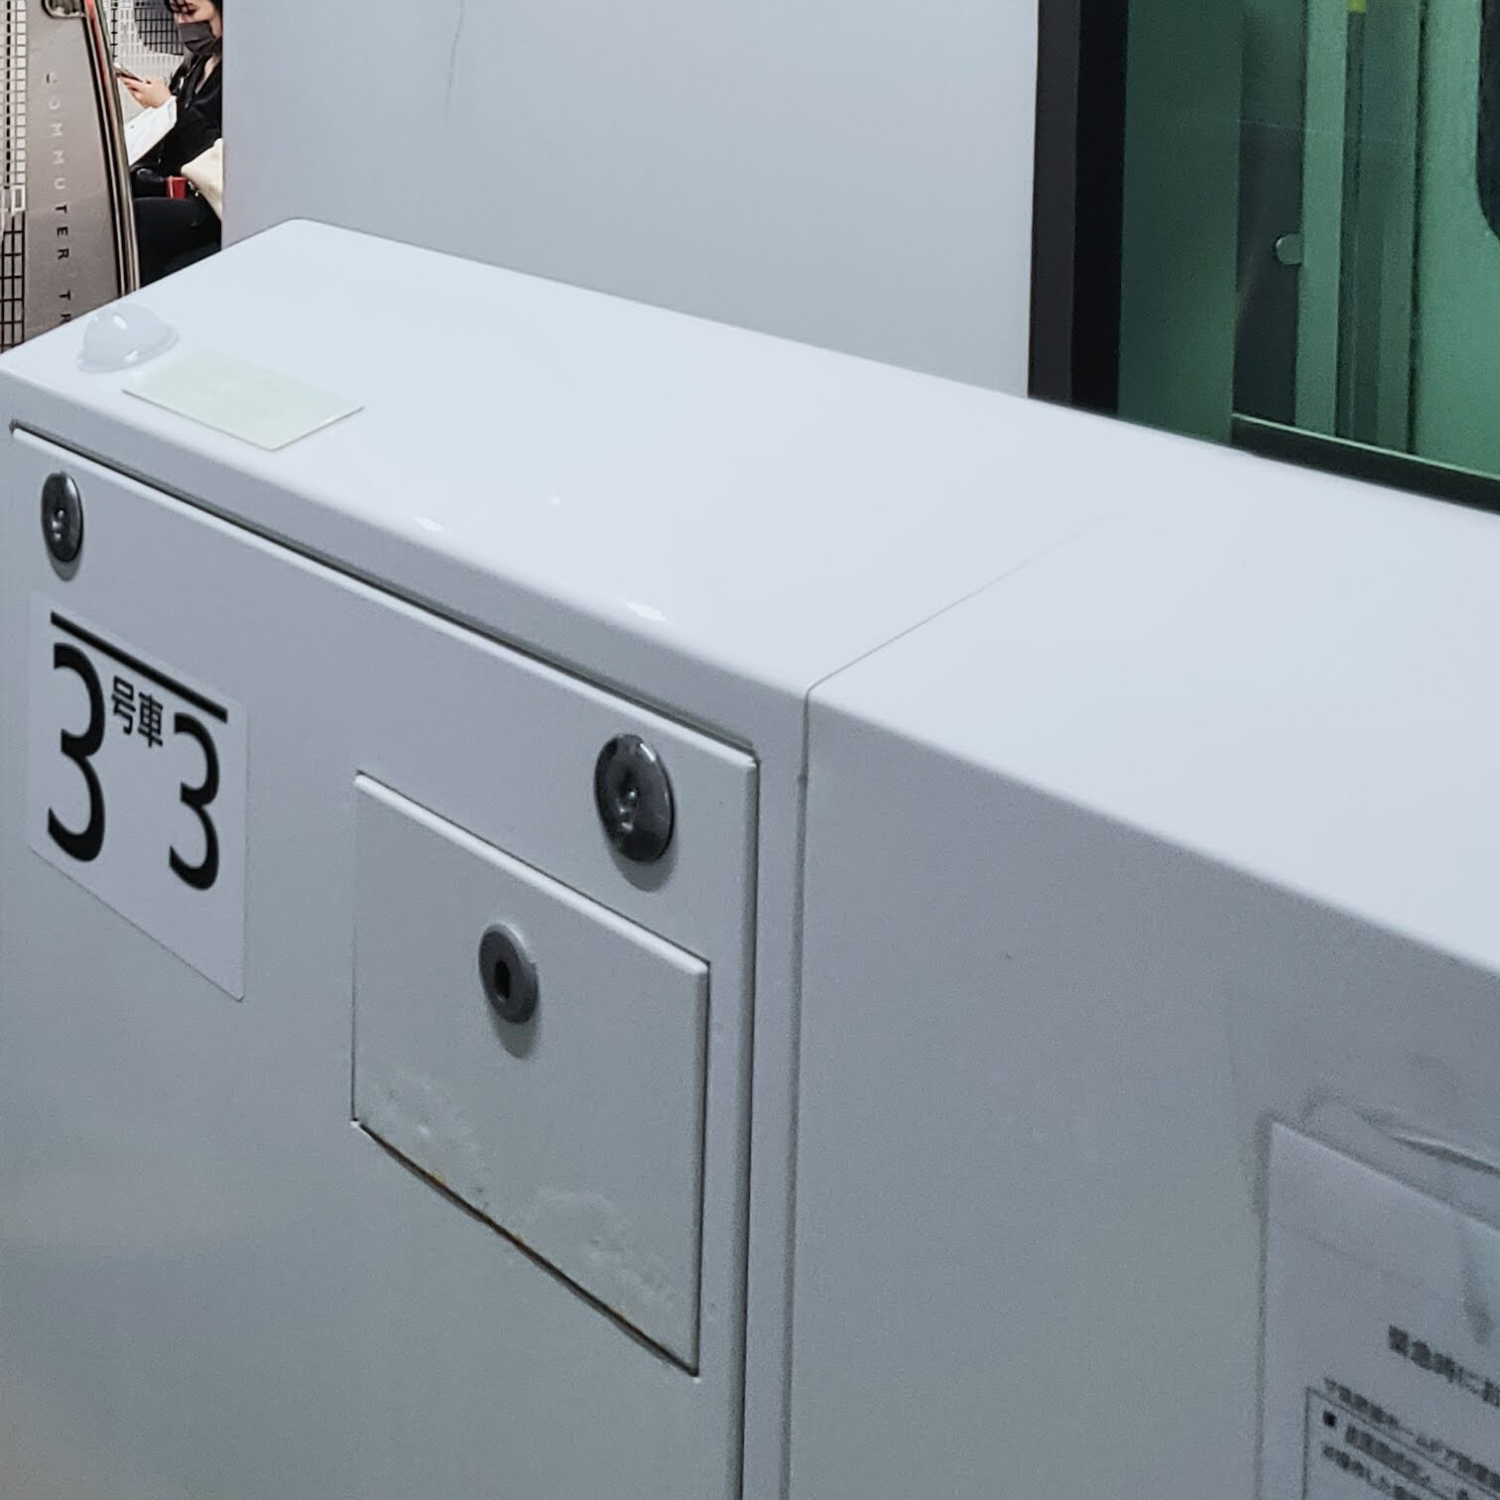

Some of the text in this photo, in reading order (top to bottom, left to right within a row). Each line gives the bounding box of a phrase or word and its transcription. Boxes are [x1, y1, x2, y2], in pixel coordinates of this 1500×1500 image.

[47, 642, 220, 892] 3 号車 3
